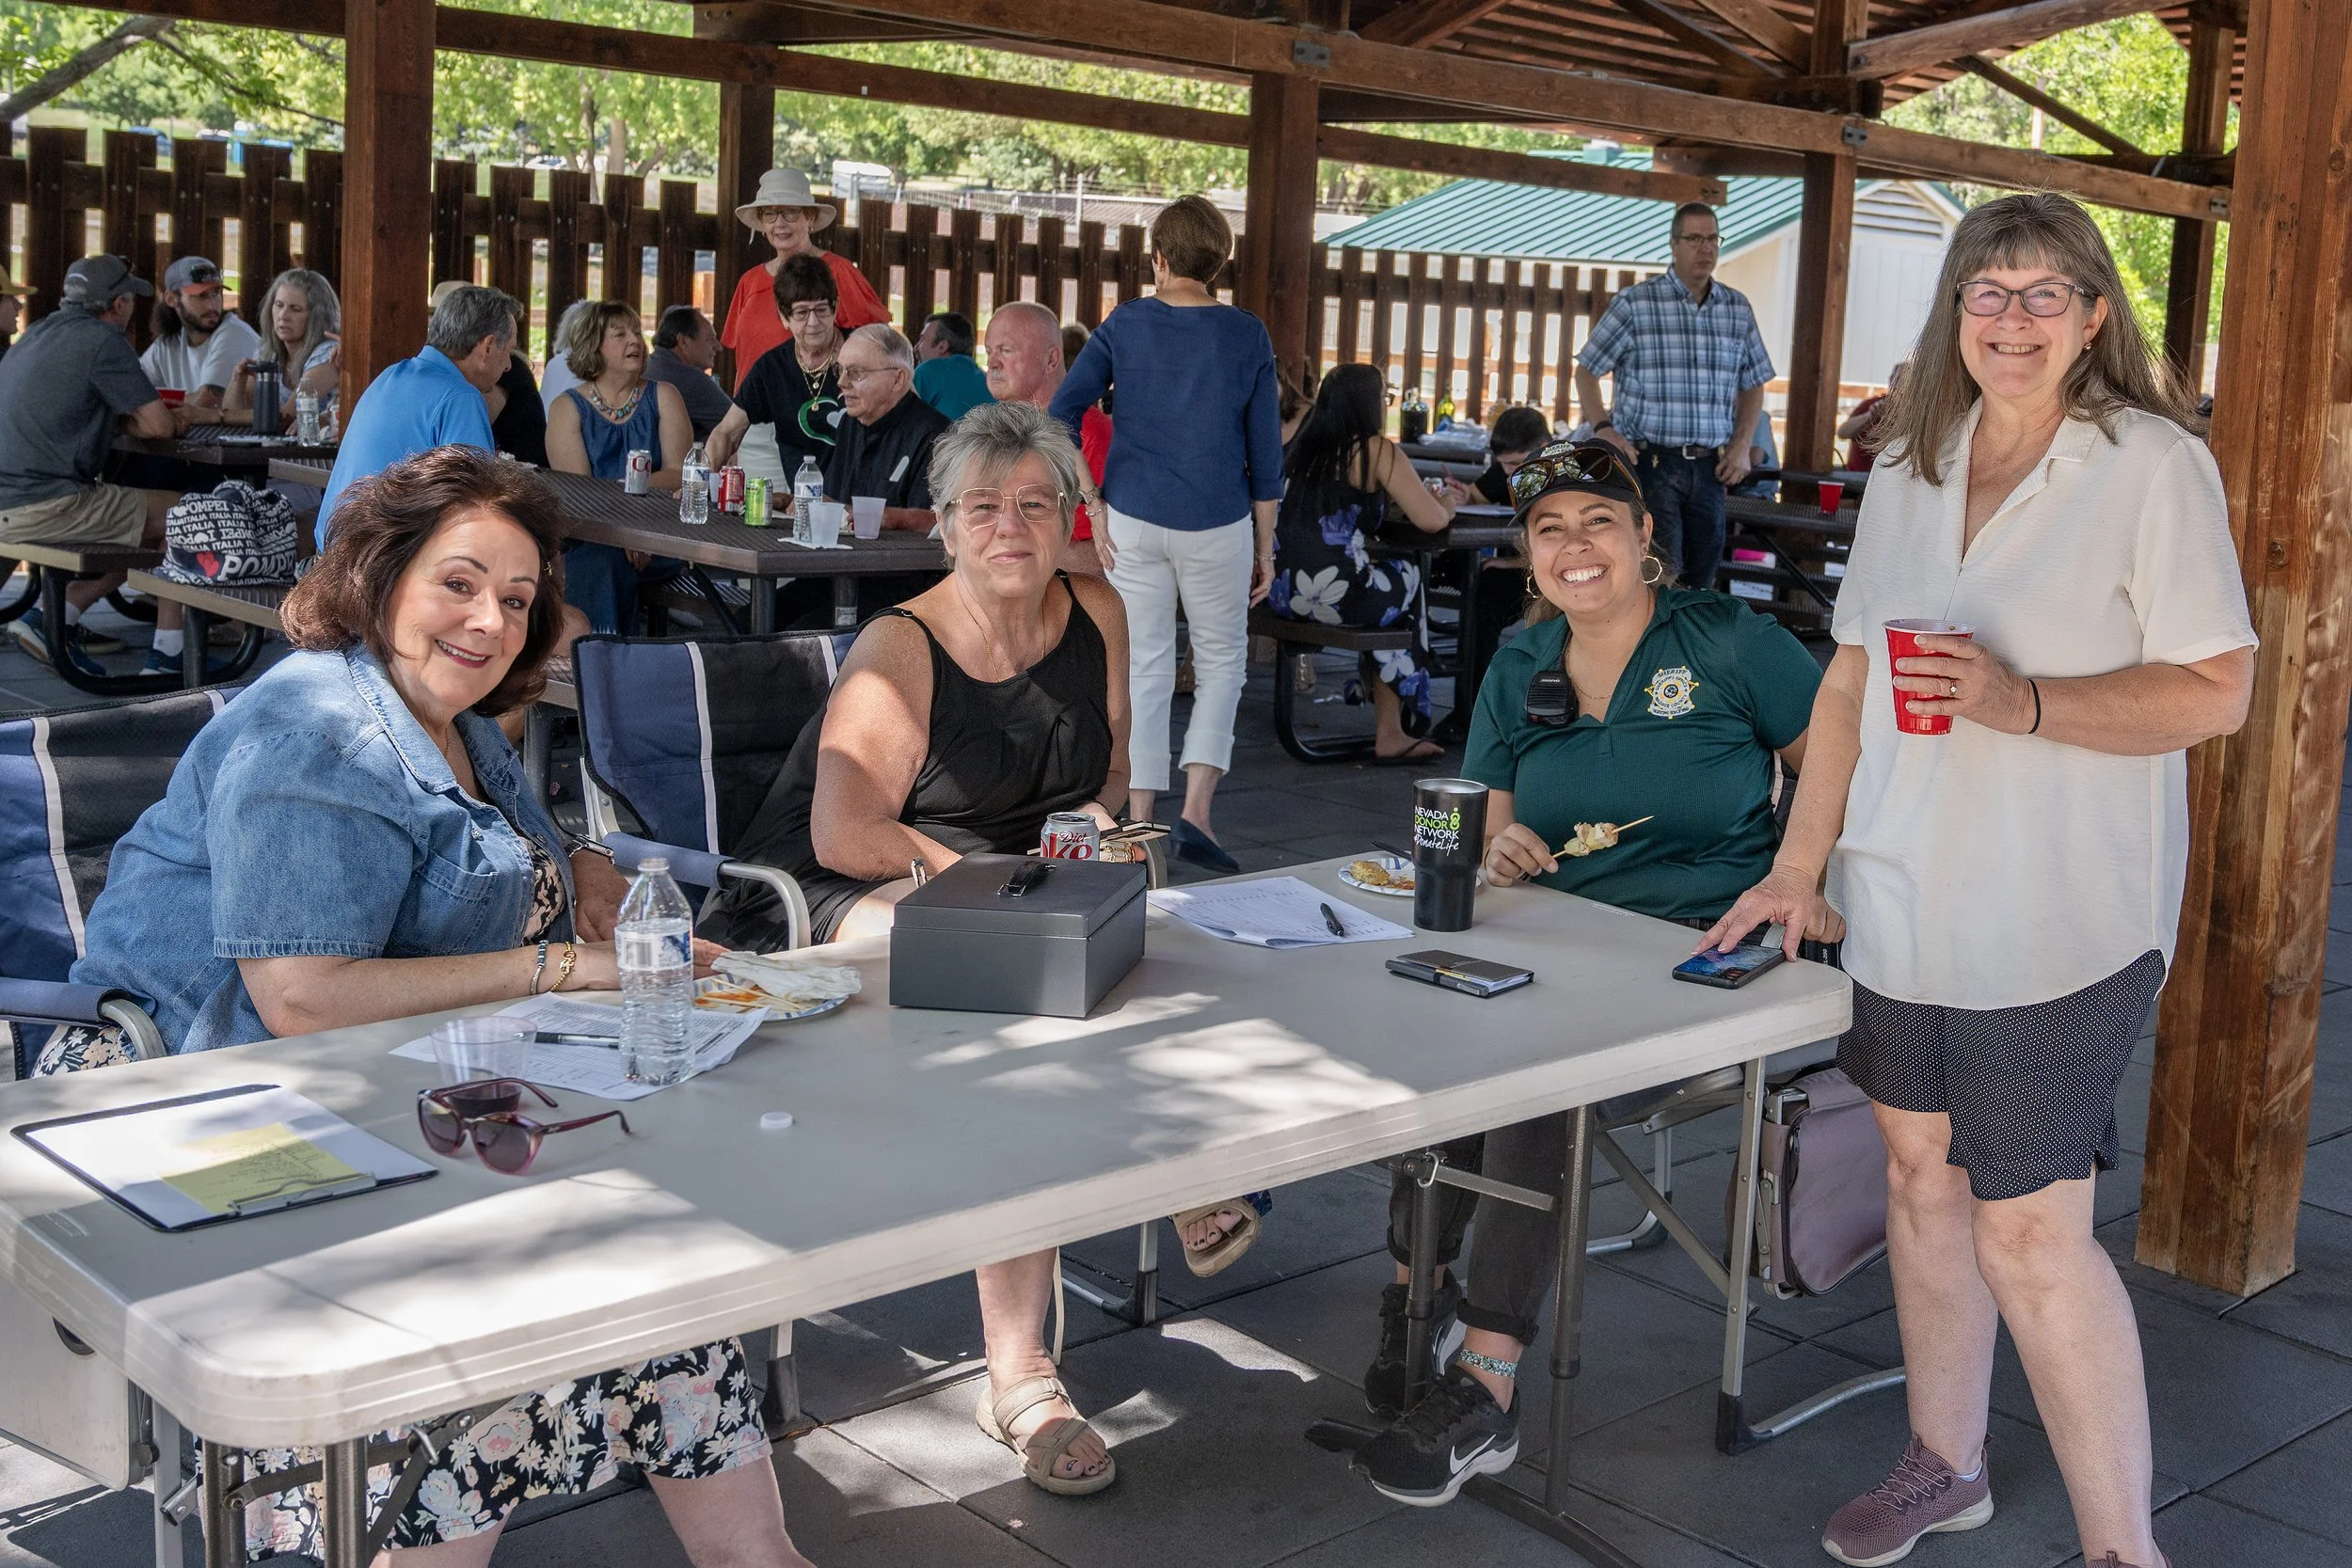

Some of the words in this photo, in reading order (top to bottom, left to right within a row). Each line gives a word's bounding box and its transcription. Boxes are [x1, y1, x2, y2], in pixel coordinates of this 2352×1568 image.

[183, 522, 215, 533] ITALIA
[212, 539, 244, 551] ITALIA
[1415, 805, 1449, 821] NEVADA
[1415, 815, 1448, 830] DONOR
[1059, 830, 1087, 843] Diet
[1414, 824, 1459, 840] NETWORK
